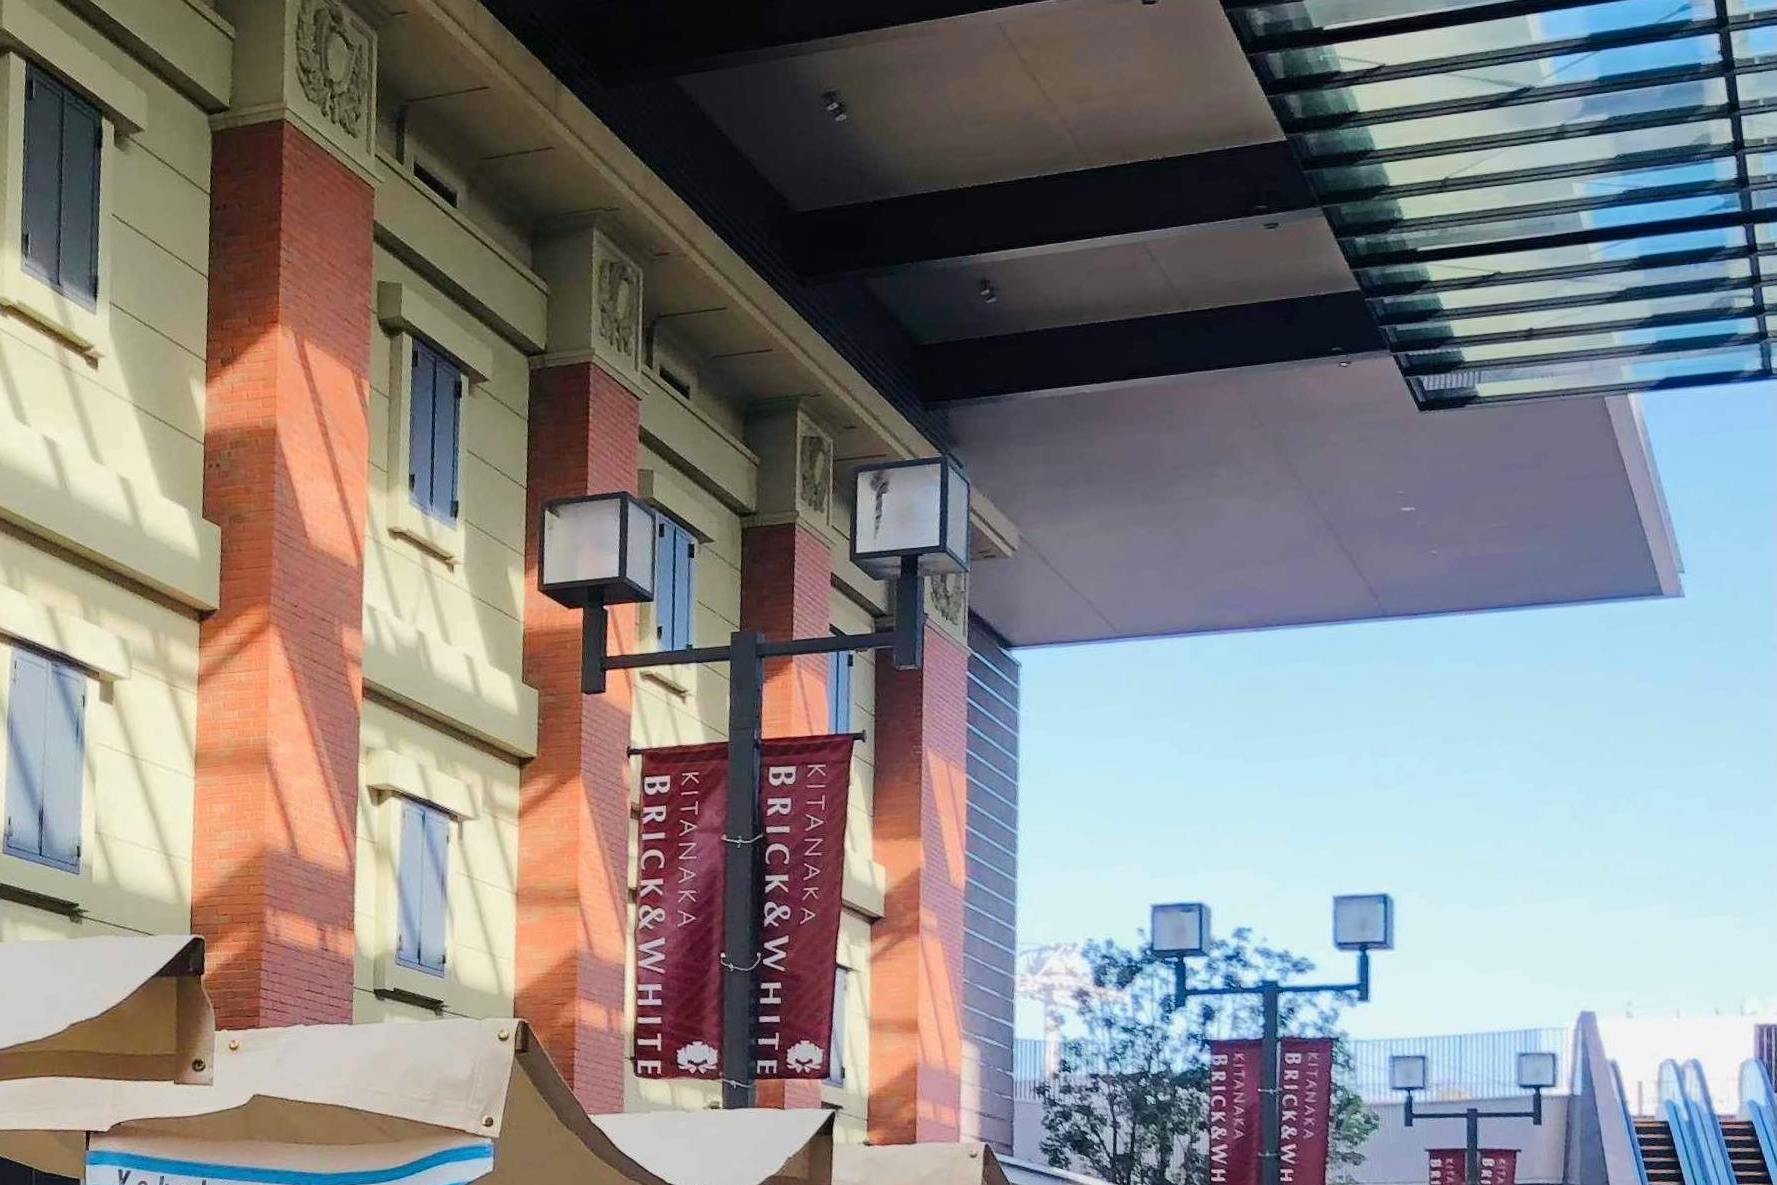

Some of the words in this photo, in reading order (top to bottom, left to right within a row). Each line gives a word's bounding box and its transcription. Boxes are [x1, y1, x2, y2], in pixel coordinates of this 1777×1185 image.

[636, 774, 671, 1075] BRICK&WHITE
[676, 771, 701, 928] KITANAKA
[755, 765, 797, 1075] BRICK&WHITE
[799, 763, 828, 925] KITANAKA
